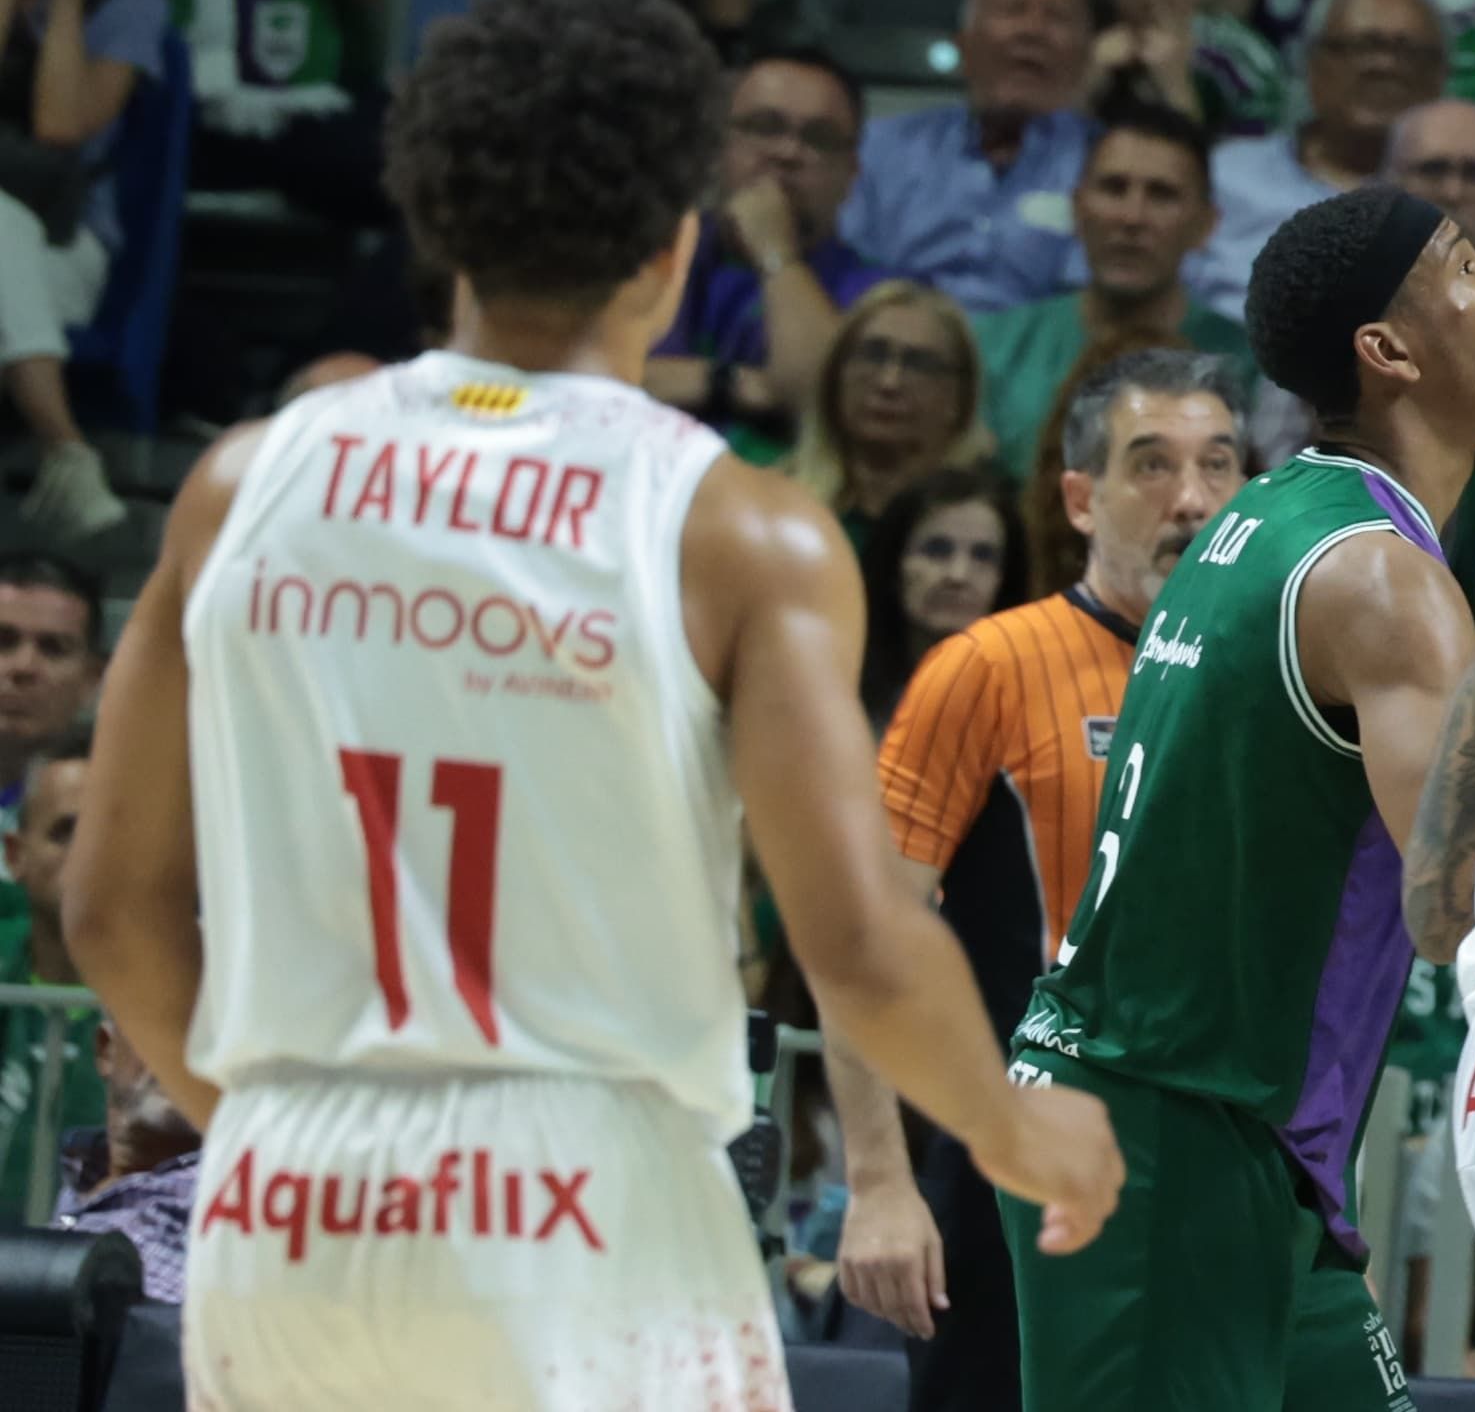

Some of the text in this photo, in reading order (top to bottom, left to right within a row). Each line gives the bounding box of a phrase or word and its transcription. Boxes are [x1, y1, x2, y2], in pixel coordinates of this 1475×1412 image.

[321, 434, 604, 550] TAYLOR
[338, 745, 504, 1049] 11
[201, 1146, 605, 1265] Aquaflix
